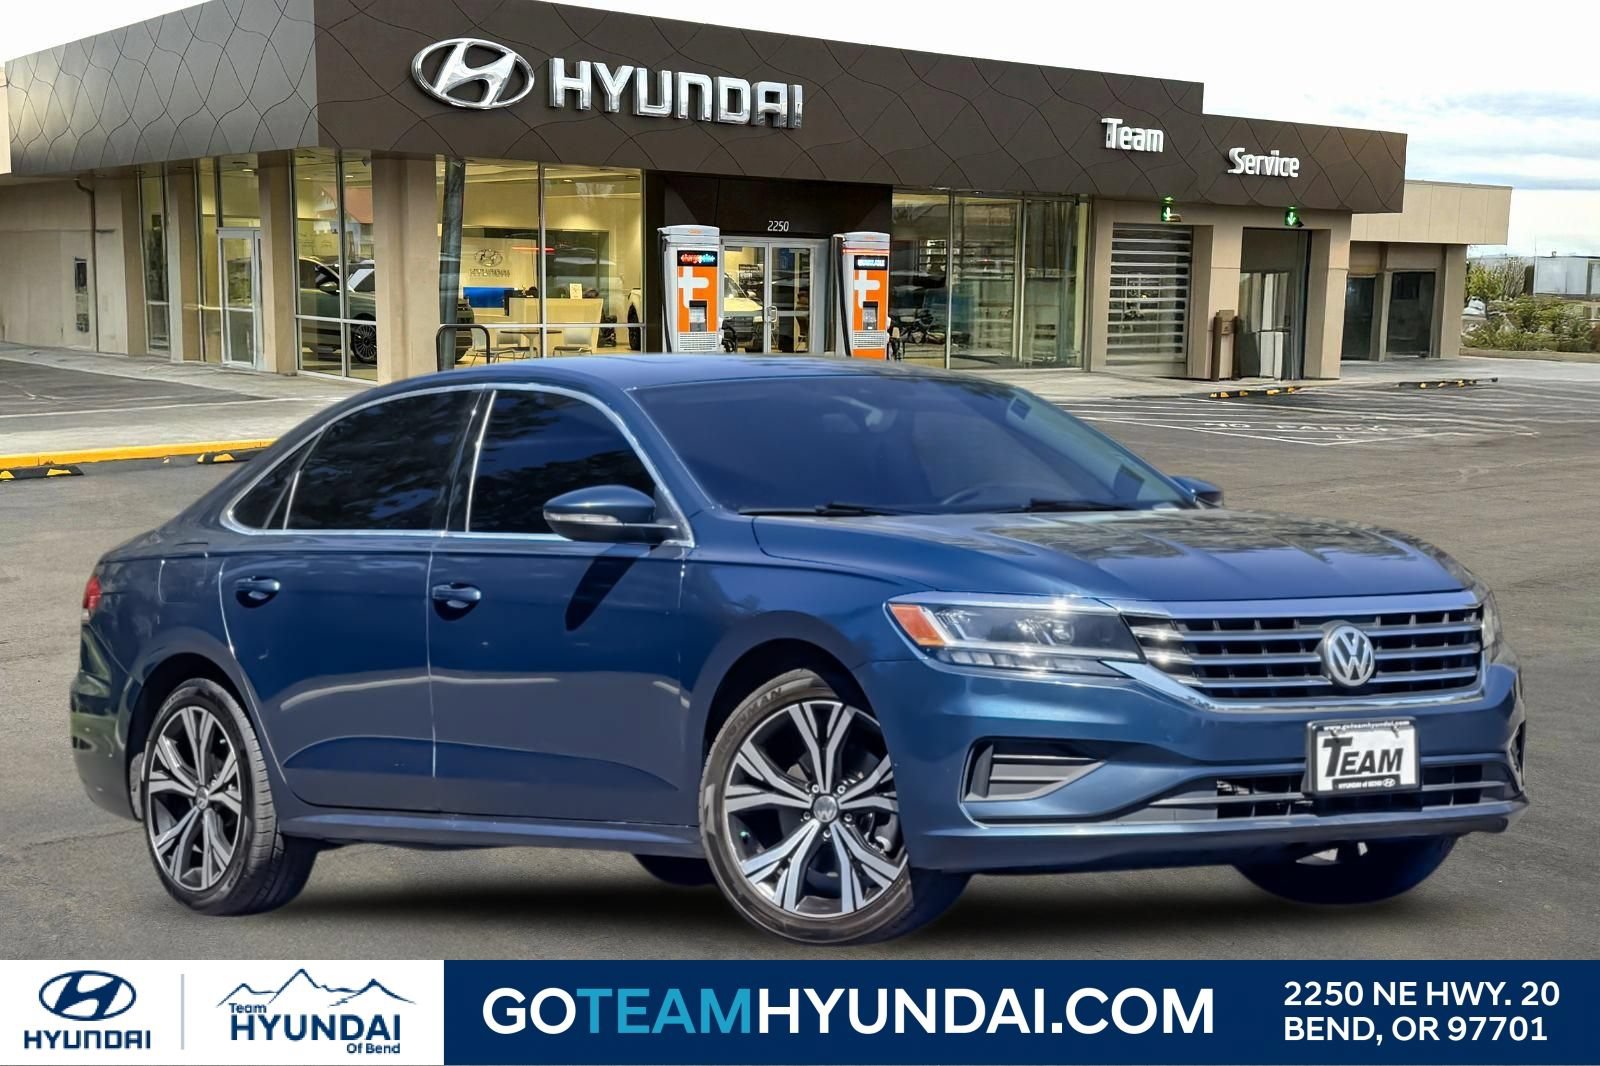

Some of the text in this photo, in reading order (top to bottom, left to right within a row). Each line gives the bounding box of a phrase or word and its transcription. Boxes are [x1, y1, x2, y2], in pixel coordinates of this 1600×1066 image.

[549, 57, 804, 129] HYUNDAI
[1101, 117, 1164, 152] Team
[1227, 147, 1300, 178] Service
[767, 220, 790, 232] 2250
